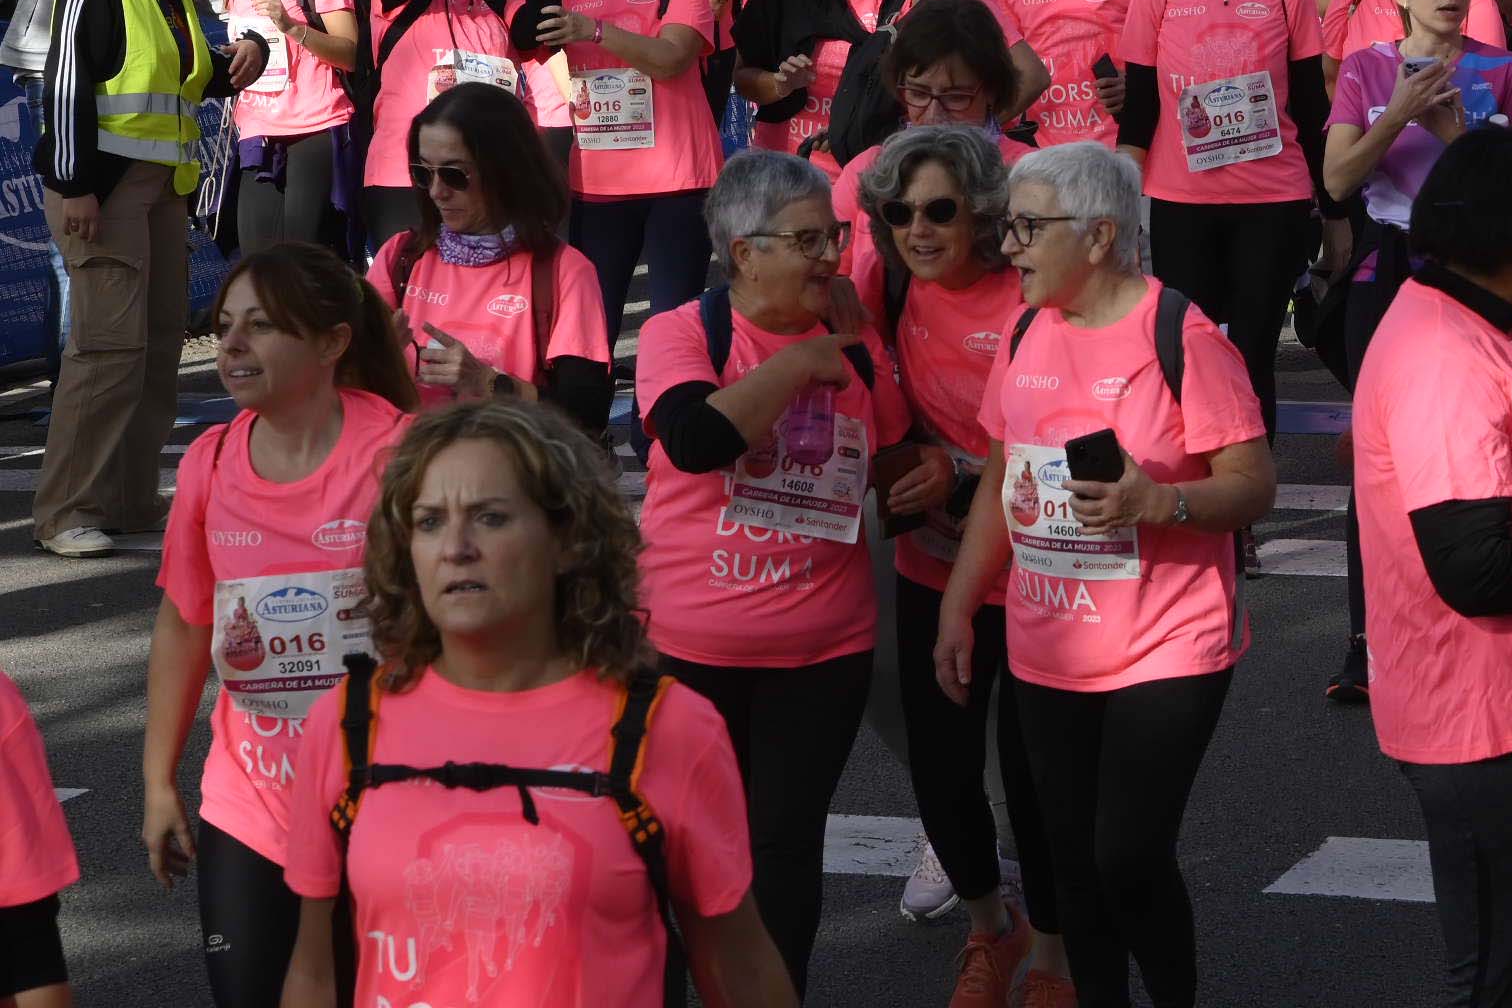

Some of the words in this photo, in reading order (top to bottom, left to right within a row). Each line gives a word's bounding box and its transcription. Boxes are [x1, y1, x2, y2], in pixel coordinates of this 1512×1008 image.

[1168, 5, 1207, 18] OYSHO
[594, 101, 621, 112] 016
[1040, 108, 1101, 129] SUMA
[1213, 110, 1245, 127] 016
[1220, 127, 1241, 137] 6474
[1196, 153, 1225, 165] OYSHO
[1016, 375, 1059, 390] OYSHO
[780, 478, 815, 493] 14608
[780, 494, 791, 503] DE
[791, 496, 801, 505] LA
[801, 497, 828, 509] MUJER
[1044, 499, 1069, 519] 01
[734, 504, 775, 520] OYSHO
[806, 517, 848, 532] Santander
[1051, 541, 1062, 550] DE
[1063, 542, 1073, 550] LA
[1074, 543, 1101, 552] MUJER
[1083, 559, 1127, 571] Santander
[1016, 567, 1097, 612] SUMA
[261, 600, 323, 616] ASTURIANA
[269, 632, 326, 656] 016
[278, 659, 321, 674] 32091
[240, 682, 283, 691] CARRERA
[286, 681, 298, 689] DE
[299, 680, 313, 688] LA
[367, 931, 416, 982] TU
